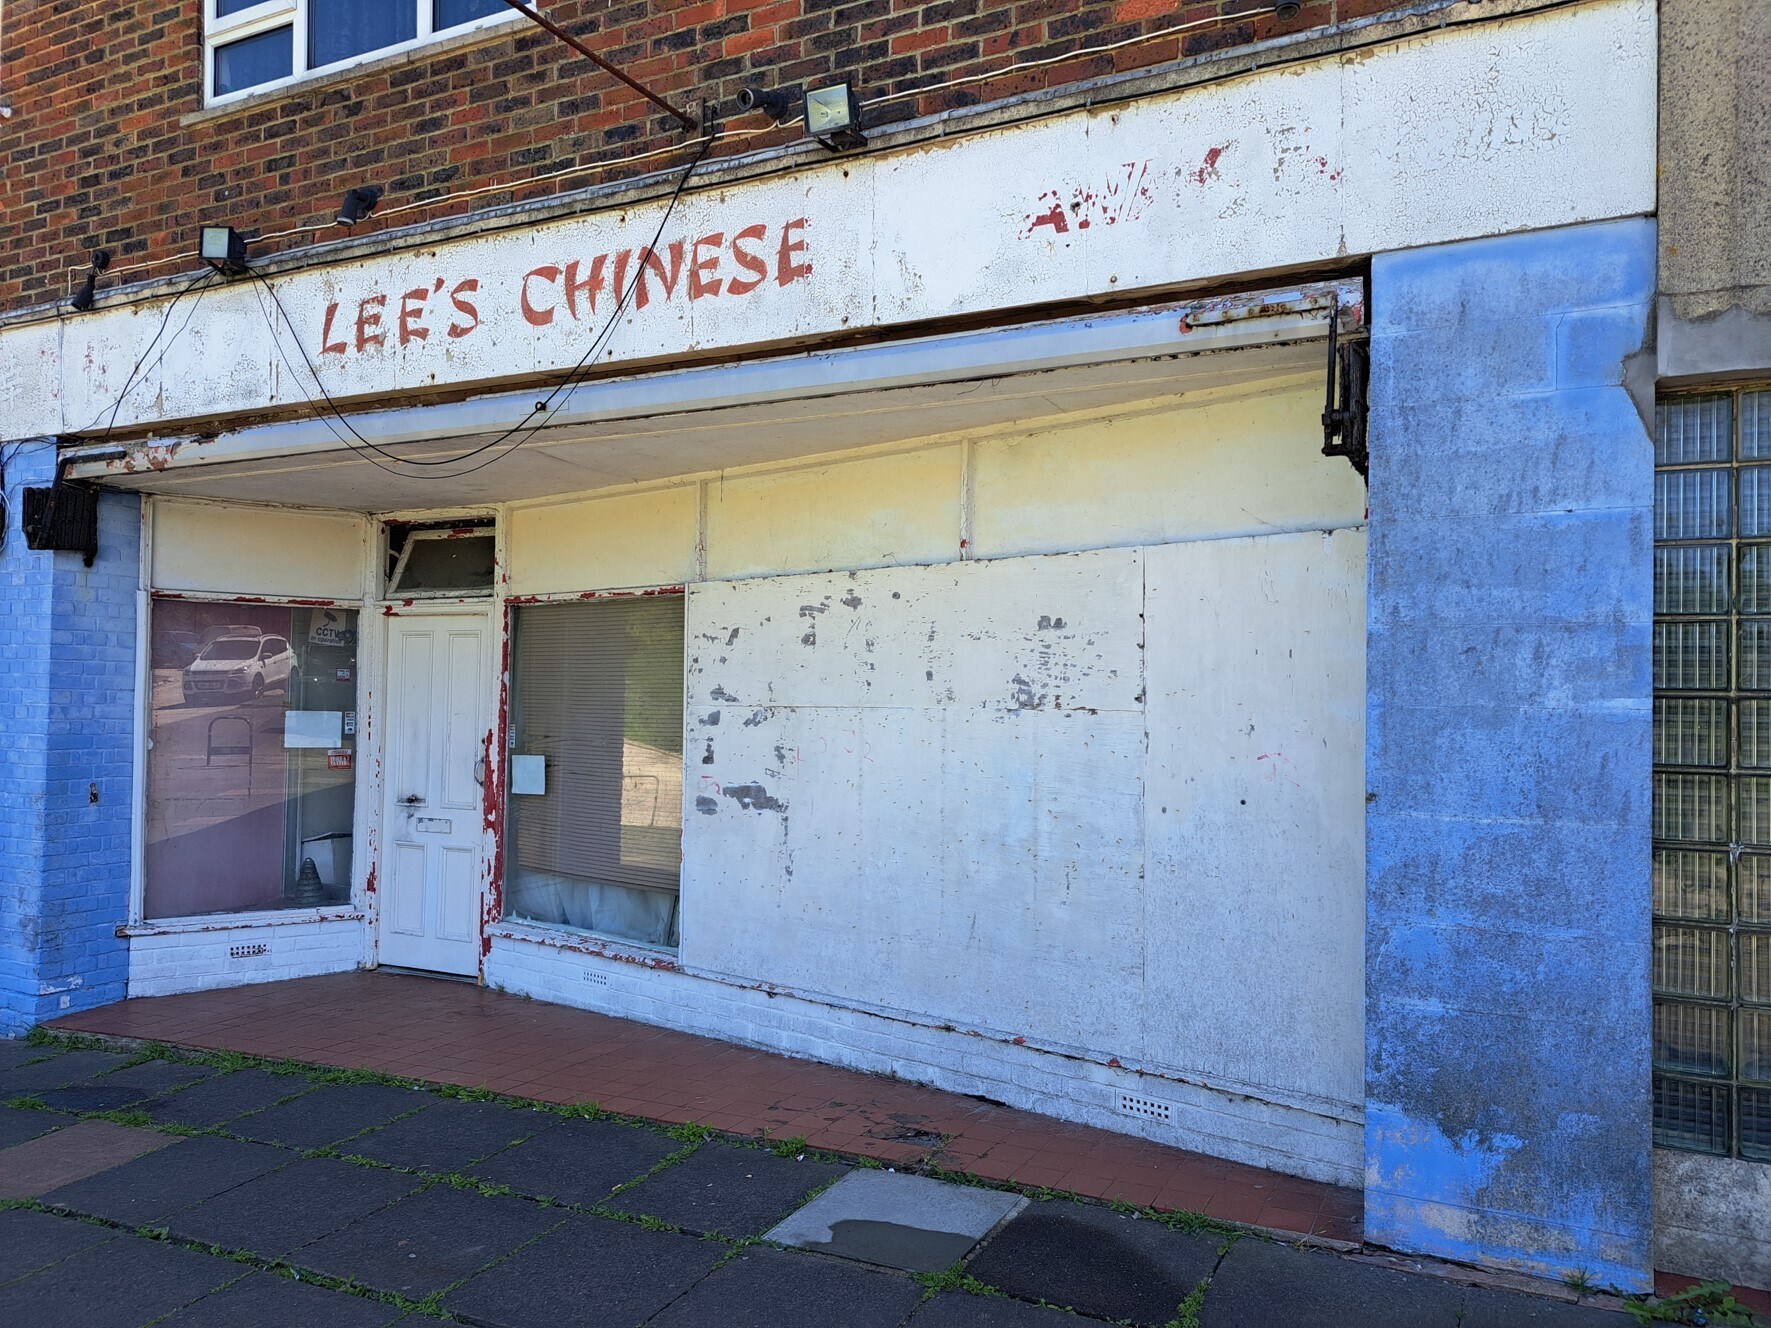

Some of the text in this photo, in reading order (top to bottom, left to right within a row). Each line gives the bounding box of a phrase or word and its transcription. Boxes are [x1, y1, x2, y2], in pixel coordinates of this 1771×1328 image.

[318, 217, 811, 356] LEE'S CHINESE
[316, 627, 340, 638] CCTV
